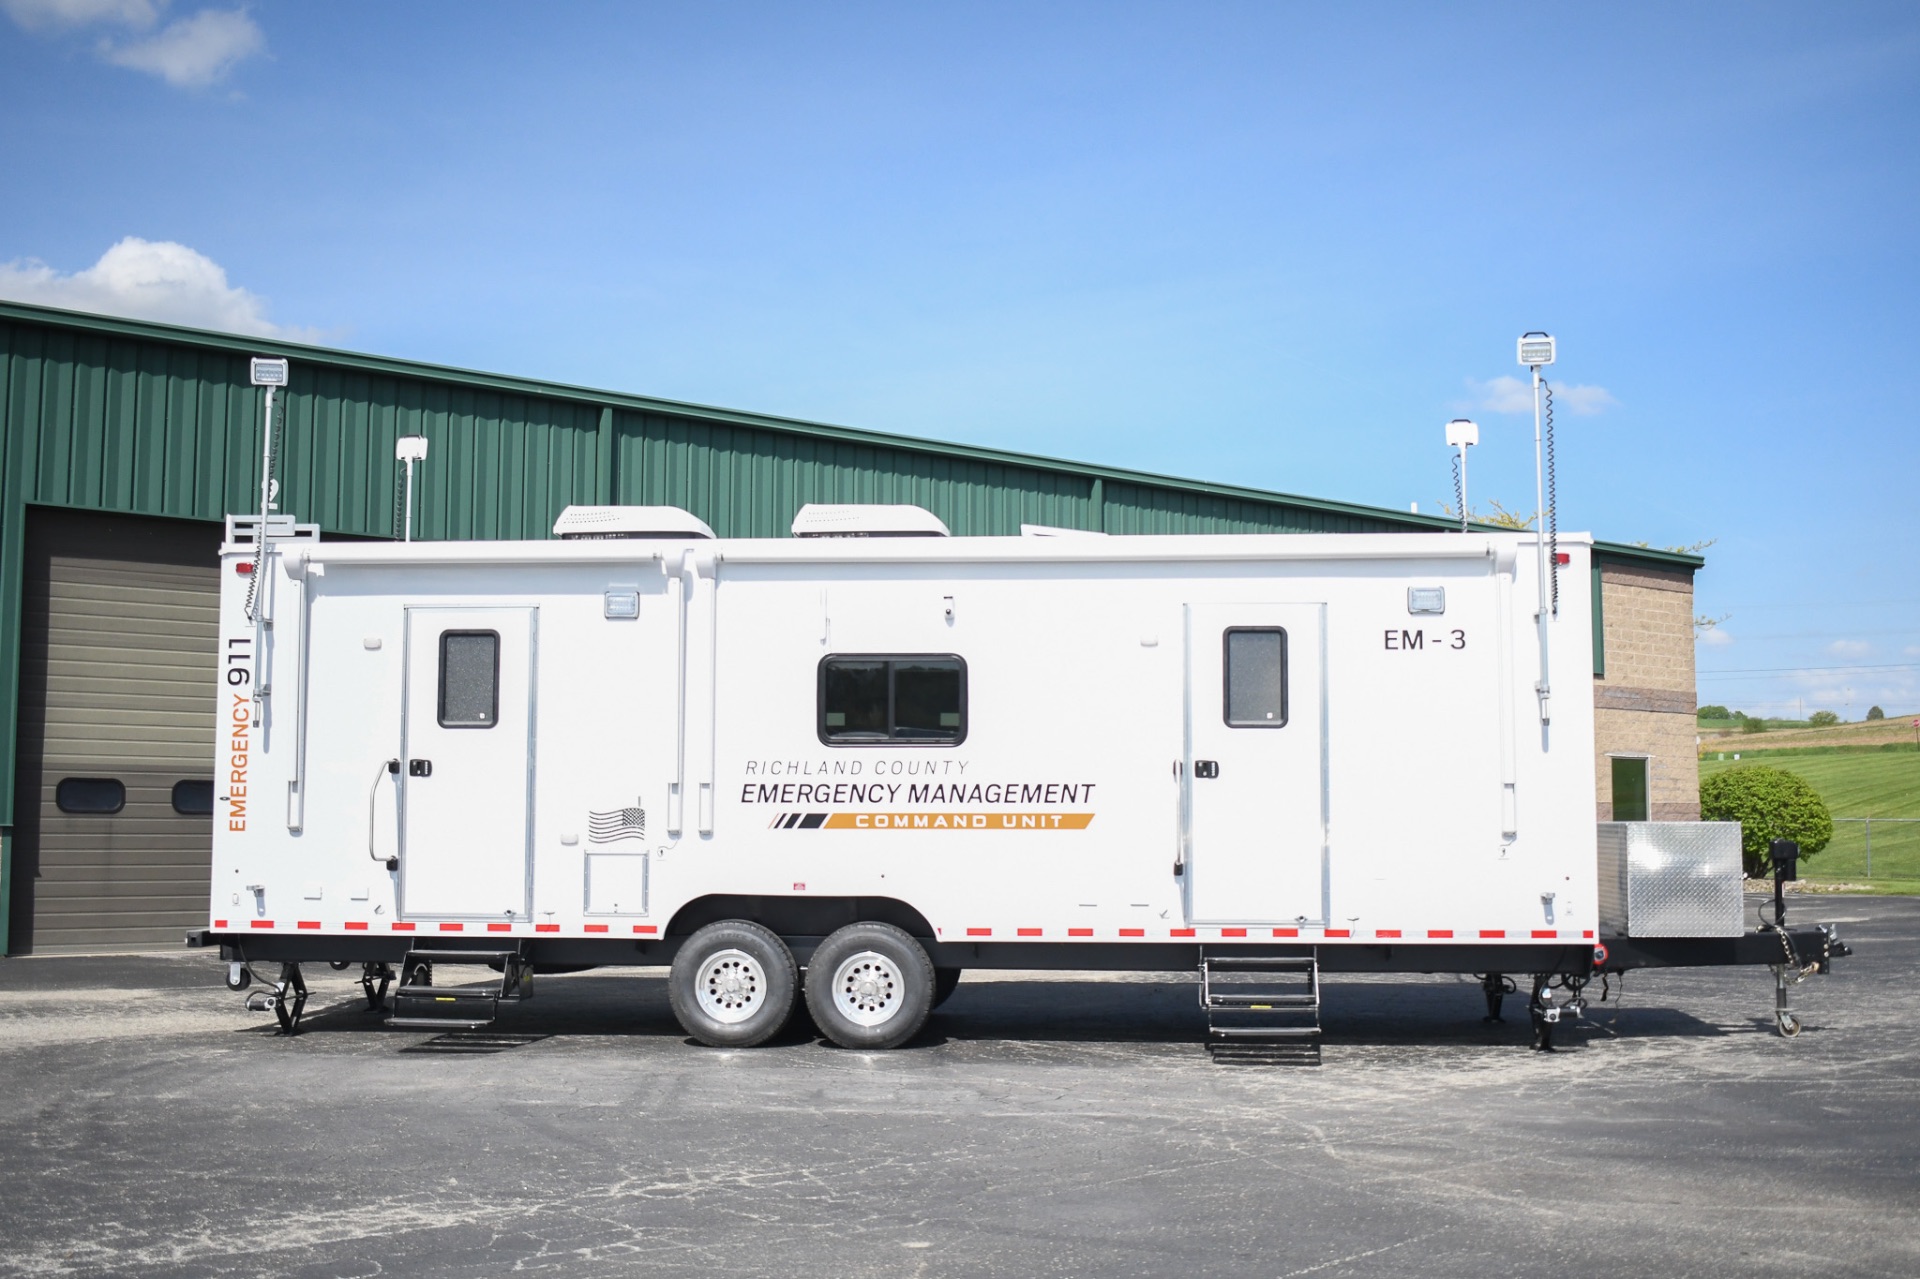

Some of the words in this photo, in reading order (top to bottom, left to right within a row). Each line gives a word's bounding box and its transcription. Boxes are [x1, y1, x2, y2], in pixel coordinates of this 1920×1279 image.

[227, 638, 252, 686] 911
[229, 693, 250, 832] EMERGENCY
[745, 760, 863, 776] RICHLAND
[874, 760, 969, 776] COUNTY
[740, 783, 902, 804] EMERGENCY
[907, 783, 1097, 804] MANAGEMENT
[855, 814, 987, 828] COMMAND
[1002, 814, 1063, 828] UNIT
